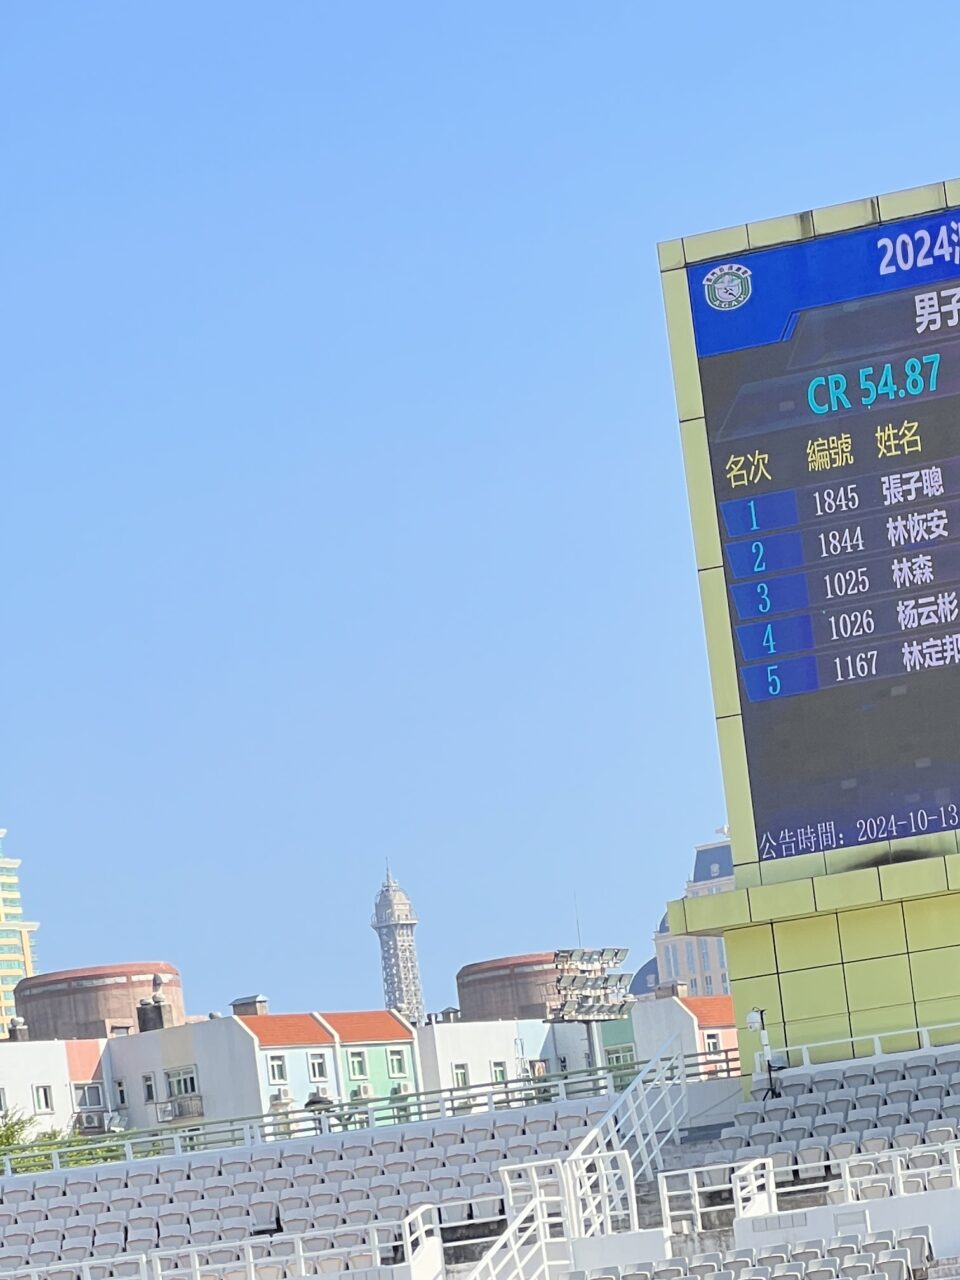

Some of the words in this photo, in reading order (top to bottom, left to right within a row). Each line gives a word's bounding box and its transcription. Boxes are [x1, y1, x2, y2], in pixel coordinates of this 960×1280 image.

[807, 373, 851, 415] CR
[859, 353, 942, 405] 54.87
[725, 450, 772, 489] 名次
[806, 433, 854, 472] 編號
[875, 420, 922, 458] 姓名
[748, 500, 760, 530] 1
[813, 485, 859, 516] 1845
[752, 542, 765, 572] 2
[818, 526, 864, 558] 1844
[757, 583, 770, 612] 3
[824, 568, 870, 599] 1025
[892, 554, 934, 589] 林森
[762, 624, 776, 654] 4
[829, 609, 875, 640] 1026
[767, 666, 781, 695] 5
[834, 651, 879, 682] 1167
[856, 804, 959, 842] 2024-10-13
